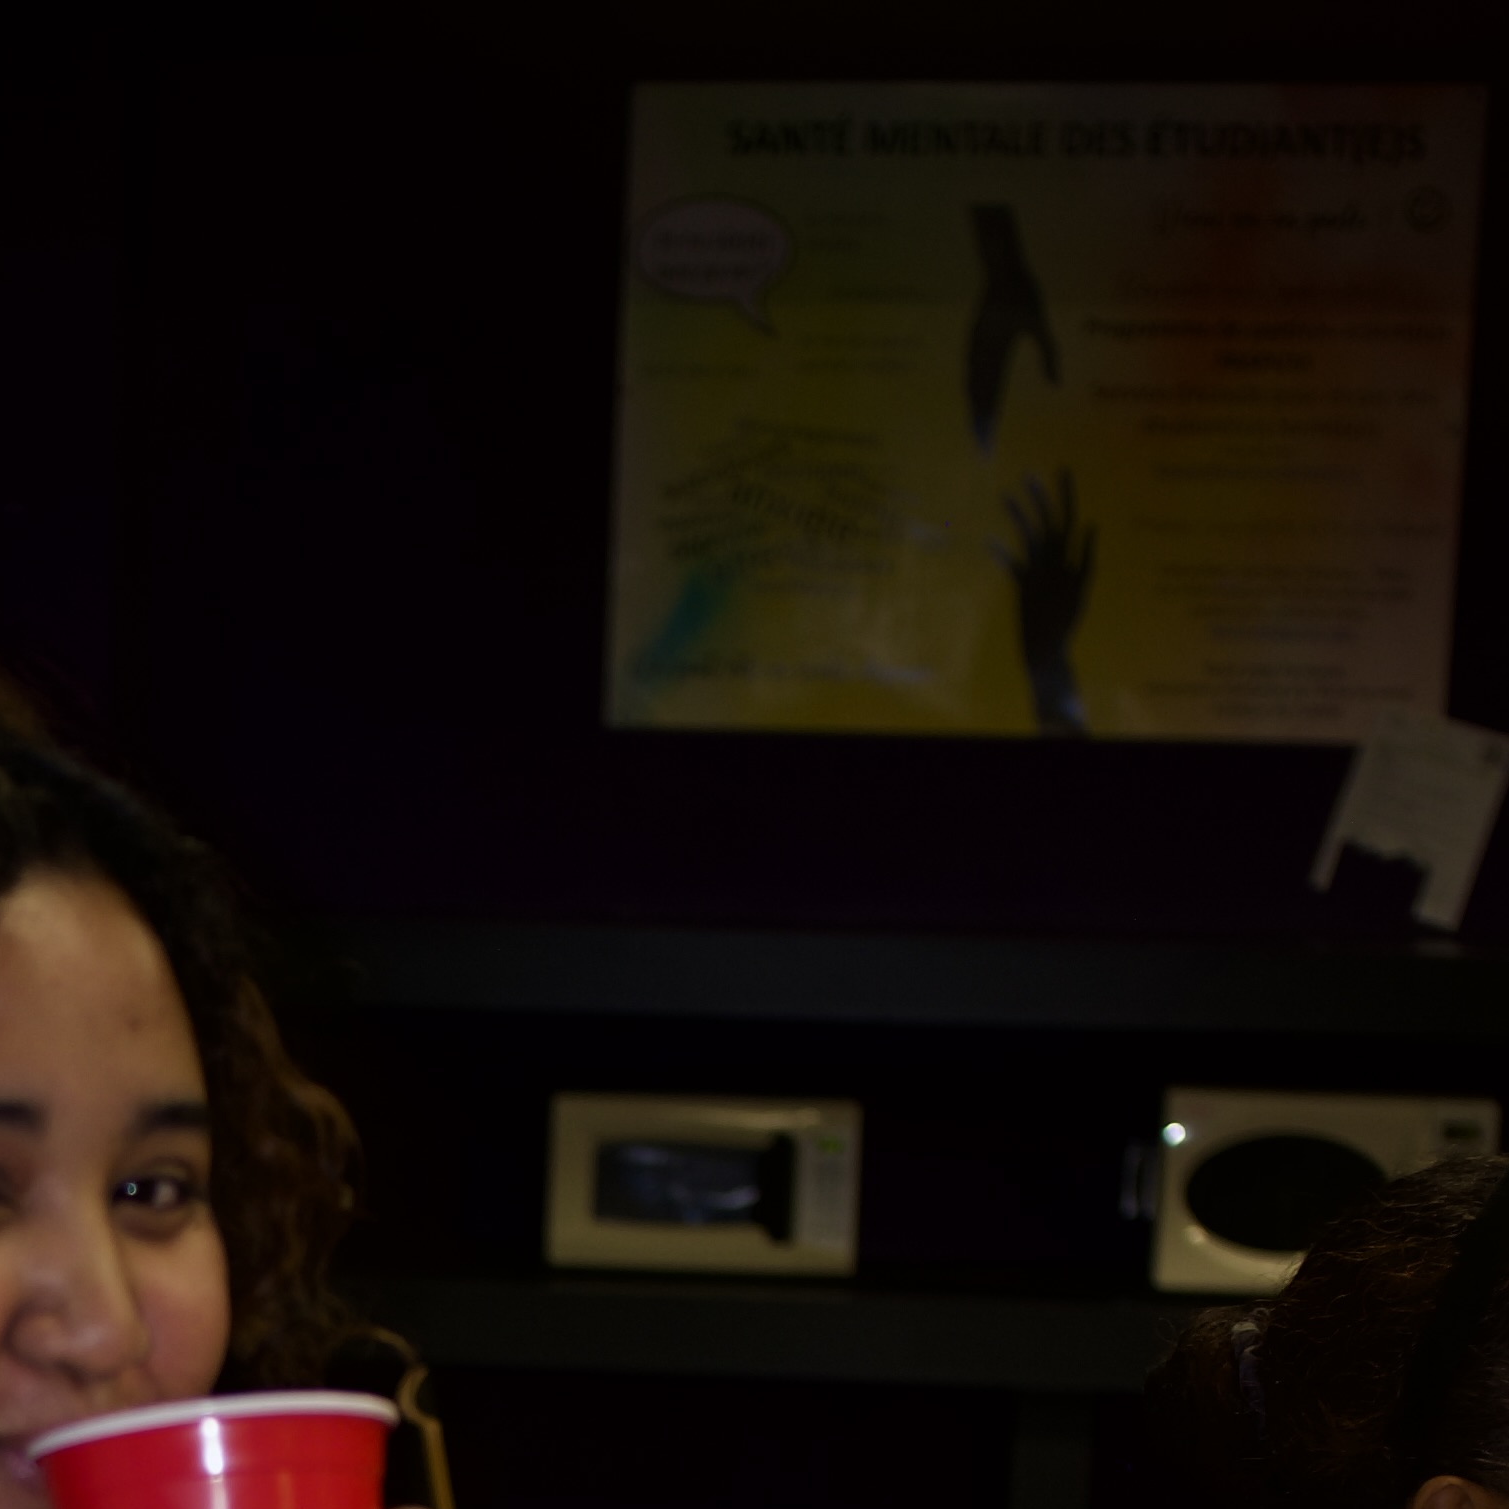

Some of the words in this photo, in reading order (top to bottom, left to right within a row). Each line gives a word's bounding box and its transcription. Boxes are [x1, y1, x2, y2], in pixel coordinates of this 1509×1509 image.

[725, 111, 854, 157] SANTÉ
[864, 119, 1048, 157] MENTALE
[1060, 120, 1135, 158] DES
[1144, 113, 1427, 165] ÉTUDIANT(E)S
